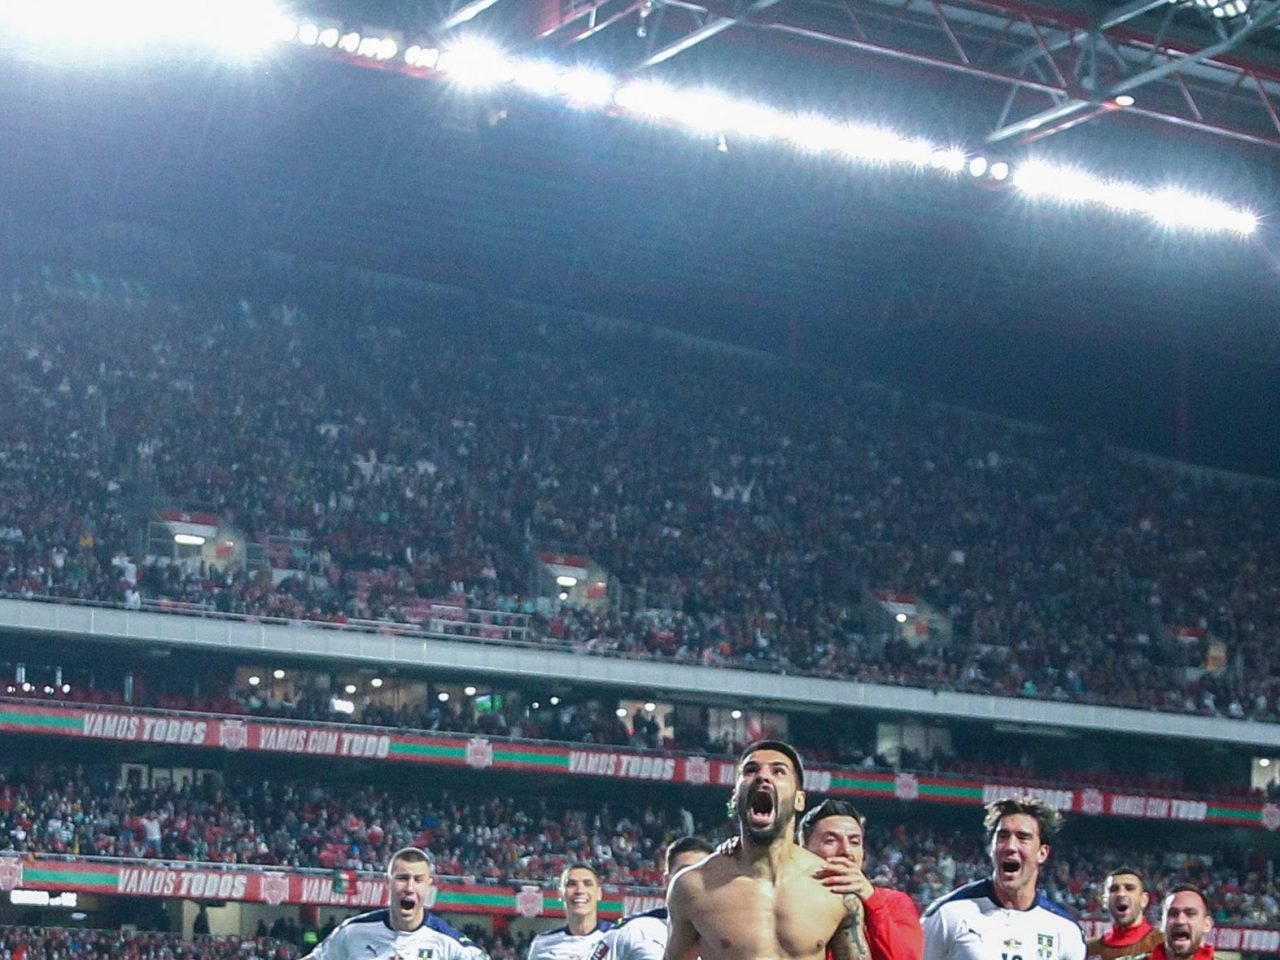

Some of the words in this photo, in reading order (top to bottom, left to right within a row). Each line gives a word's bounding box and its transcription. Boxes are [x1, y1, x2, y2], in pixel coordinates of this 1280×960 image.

[83, 712, 140, 741] VAMOS
[141, 716, 207, 745] TODOS
[259, 726, 307, 751] VAMOS
[307, 730, 339, 755] COM
[341, 733, 391, 759] TUDO
[569, 751, 617, 776] VAMOS
[619, 754, 676, 781] TODOS
[118, 868, 176, 896] VAMOS
[179, 872, 248, 899] TODOS
